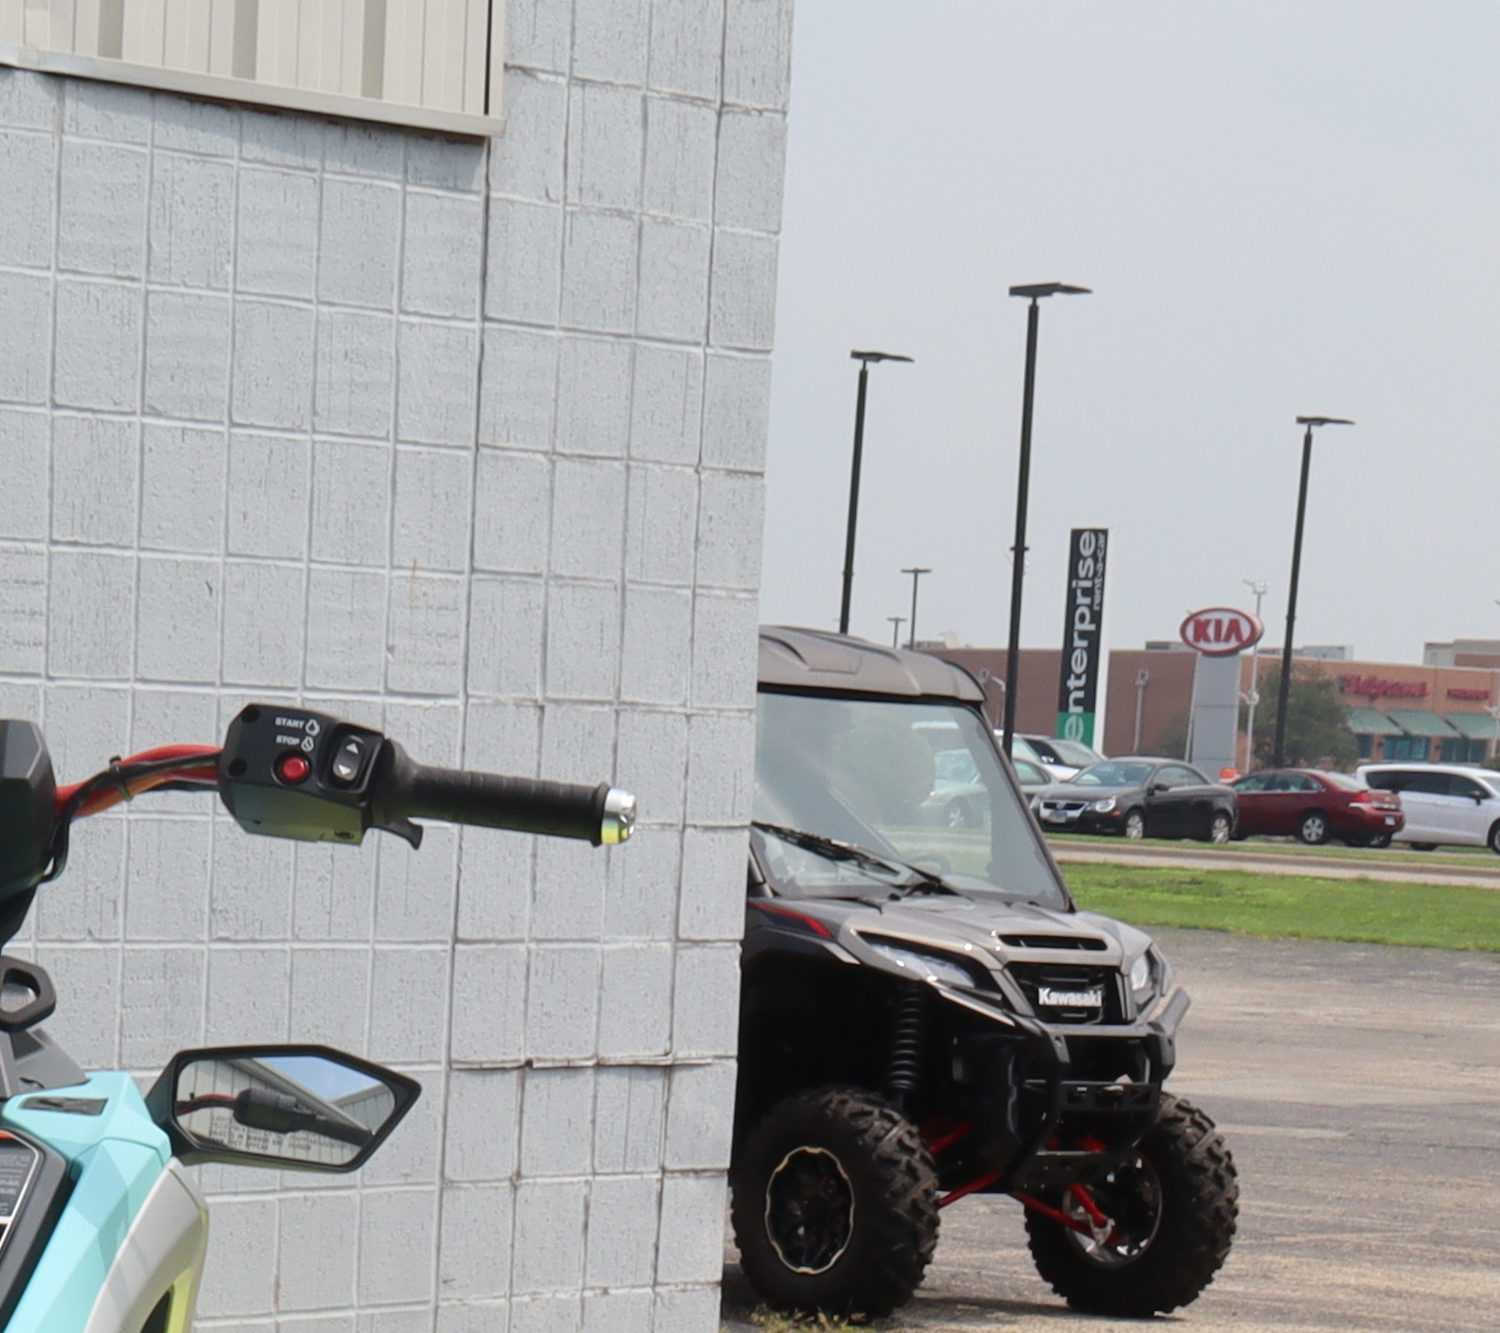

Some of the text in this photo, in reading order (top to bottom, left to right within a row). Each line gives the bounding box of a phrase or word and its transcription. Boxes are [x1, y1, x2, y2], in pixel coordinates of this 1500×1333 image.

[1093, 533, 1106, 611] rent-a-car
[1064, 531, 1096, 741] enterprise
[1192, 618, 1244, 643] KIA
[274, 717, 305, 730] START
[275, 735, 300, 746] STOP
[1038, 987, 1103, 1008] Kawasaki
